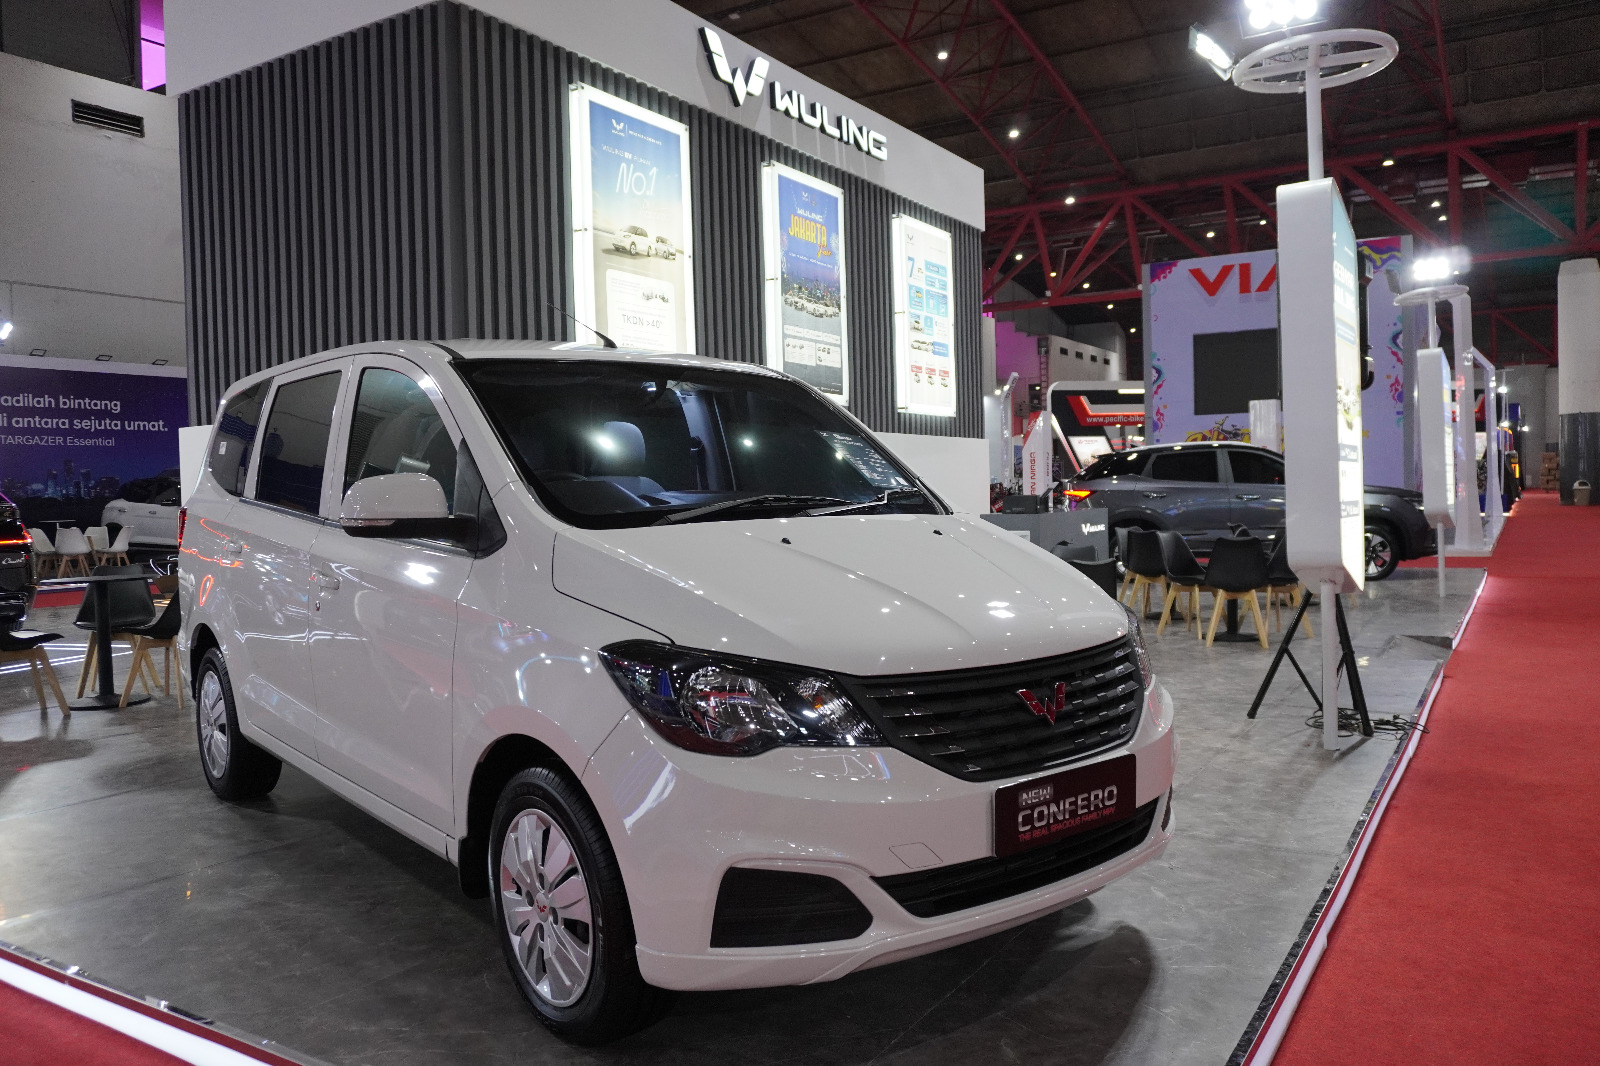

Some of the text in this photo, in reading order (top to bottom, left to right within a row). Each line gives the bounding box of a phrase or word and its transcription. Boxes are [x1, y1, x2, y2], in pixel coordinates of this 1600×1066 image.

[770, 80, 888, 161] WULING
[797, 207, 823, 222] WULING
[788, 214, 827, 248] JAKARTA
[1, 393, 121, 413] adilah bintang
[12, 415, 69, 429] antara
[73, 417, 121, 432] sejuta
[125, 419, 168, 432] umat.
[0, 435, 115, 447] TARGAZER Essential
[1022, 786, 1051, 806] NEW
[1017, 784, 1118, 832] CONFERO
[1018, 807, 1116, 842] THE REAL SPACIOUS FAMILY MPV
